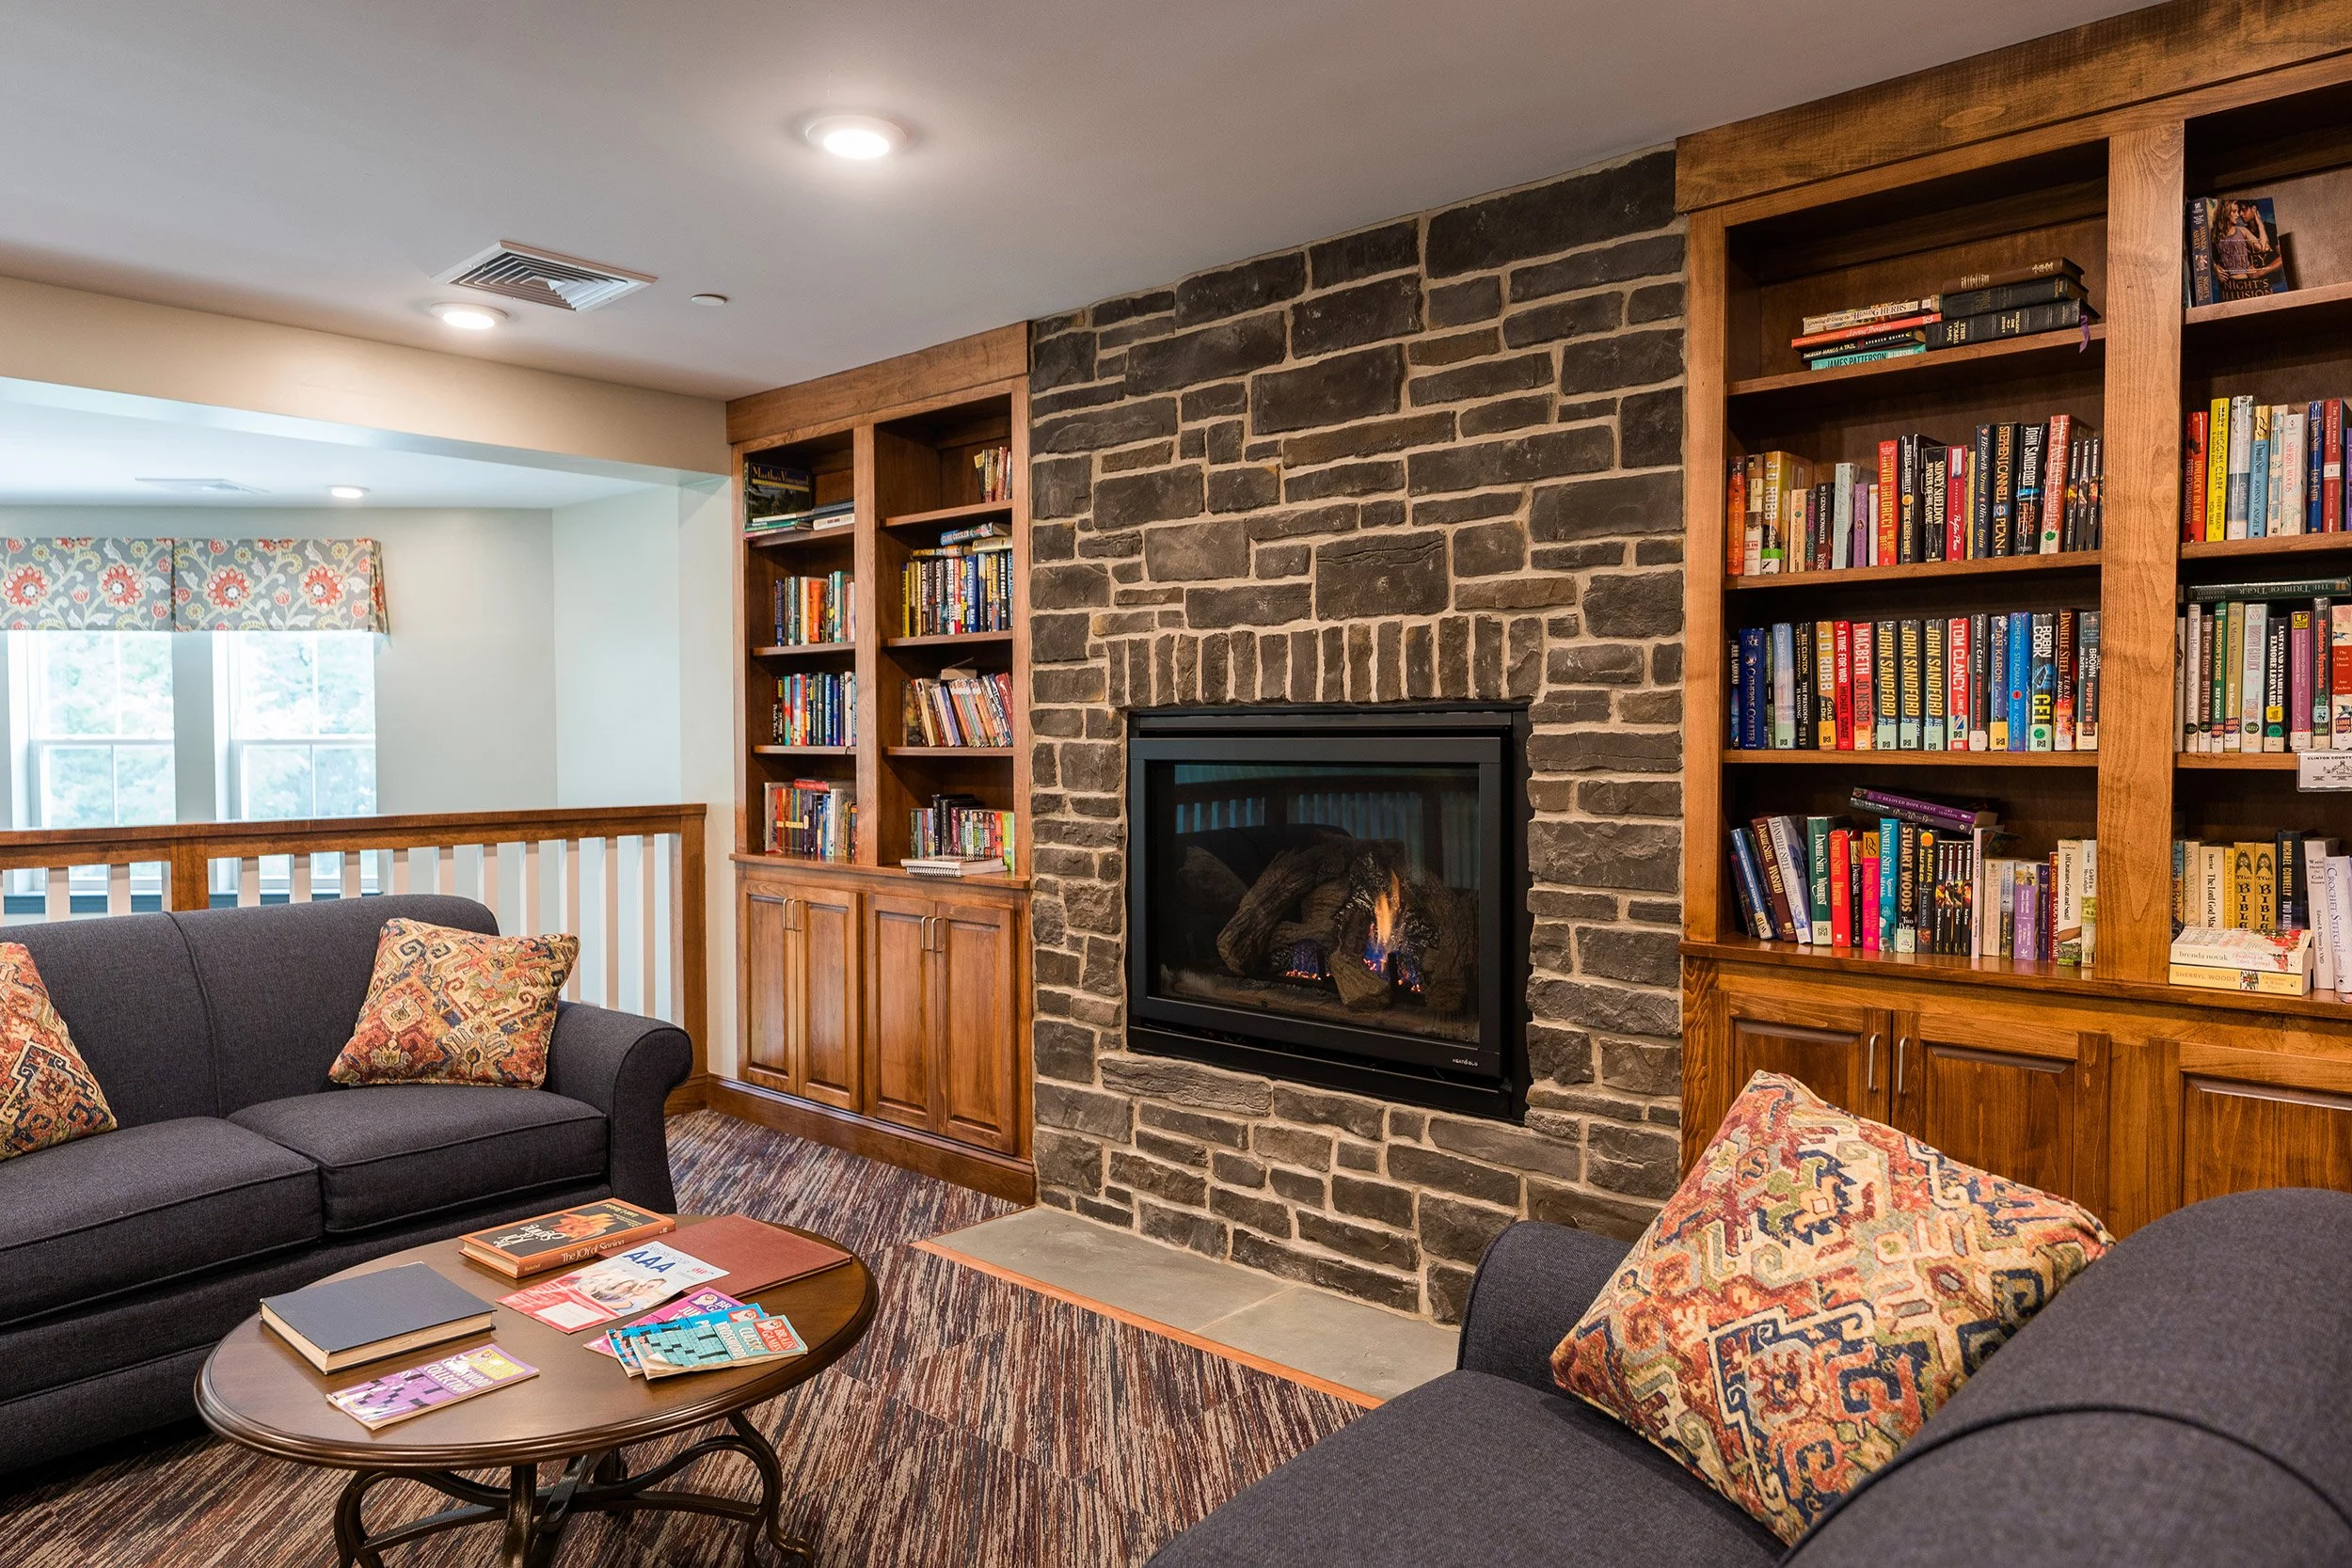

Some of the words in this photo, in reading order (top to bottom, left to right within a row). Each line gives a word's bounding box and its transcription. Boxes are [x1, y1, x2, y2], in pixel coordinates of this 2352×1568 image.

[1849, 353, 1887, 365] PATTERSON
[1998, 426, 2010, 460] STEPHEN
[2025, 426, 2040, 446] JOHN
[1979, 436, 1989, 470] Elizabeth
[2023, 447, 2039, 486] SANDFORD
[1882, 456, 1893, 483] DAVID
[1934, 461, 1944, 488] SIDNEY
[1995, 465, 2009, 503] CANNELL
[2193, 460, 2202, 494] UNLUCKY
[1881, 485, 1893, 528] BALDACCI
[1933, 488, 1944, 525] SHELDON
[2193, 495, 2201, 503] IN
[1925, 506, 1933, 524] GAME
[2253, 507, 2262, 530] ANGEL
[1977, 527, 1986, 548] Again
[1995, 518, 2006, 548] PLAN
[2238, 587, 2268, 595] TIGER
[2283, 583, 2311, 594] TRIBE
[1837, 636, 1846, 652] TIME
[1879, 628, 1893, 658] JOHN
[1902, 627, 1916, 657] JOHN
[1927, 626, 1941, 657] JOHN
[1953, 624, 1965, 648] TOM
[2033, 626, 2042, 657] COOK
[2042, 626, 2052, 657] ROBIN
[2059, 612, 2072, 649] DANIELLE
[2215, 620, 2223, 659] BRANDON'S
[2317, 619, 2327, 653] Mistletoe
[1838, 654, 1847, 667] FOR
[1855, 628, 1869, 674] MACBETH
[2059, 650, 2071, 673] STEEL
[2269, 635, 2278, 669] ELMORE
[1838, 668, 1847, 684] WAR
[1952, 649, 1965, 692] CLANCY
[2215, 660, 2223, 680] POSSE
[2278, 665, 2283, 673] AT
[2316, 653, 2327, 689] Mysteries
[1746, 668, 1756, 706] CATHERINE
[1881, 659, 1896, 716] SANDFORD
[1904, 658, 1919, 716] SANDFORD
[1927, 658, 1943, 716] SANDFORD
[2086, 682, 2094, 712] PUPPET
[2268, 670, 2278, 706] LEONARD
[1746, 708, 1756, 742] COULTER
[1883, 797, 1905, 805] BELOVED
[1772, 820, 1785, 851] DANIELLE
[1780, 852, 1789, 872] STEEL
[1815, 833, 1826, 857] DANIELLE
[1882, 823, 1892, 854] DANIELLE
[1901, 827, 1913, 869] STUART
[2282, 841, 2292, 865] MICHAEL
[1816, 857, 1827, 875] STEEL
[1882, 855, 1892, 875] STEEL
[2207, 874, 2216, 886] The
[1901, 871, 1913, 912] WOODS
[2207, 886, 2216, 900] Lord
[2282, 867, 2292, 896] CONNELLY
[2327, 867, 2338, 911] CROCHET
[2207, 901, 2216, 914] God
[2330, 913, 2342, 948] STITCH
[2179, 951, 2204, 959] brenda
[2205, 953, 2229, 961] novak
[2175, 971, 2206, 980] SHERRYL
[561, 1253, 576, 1262] The
[576, 1246, 592, 1262] JOY
[591, 1245, 599, 1254] of
[622, 1250, 676, 1274] AAA
[773, 1327, 795, 1351] BRAIN
